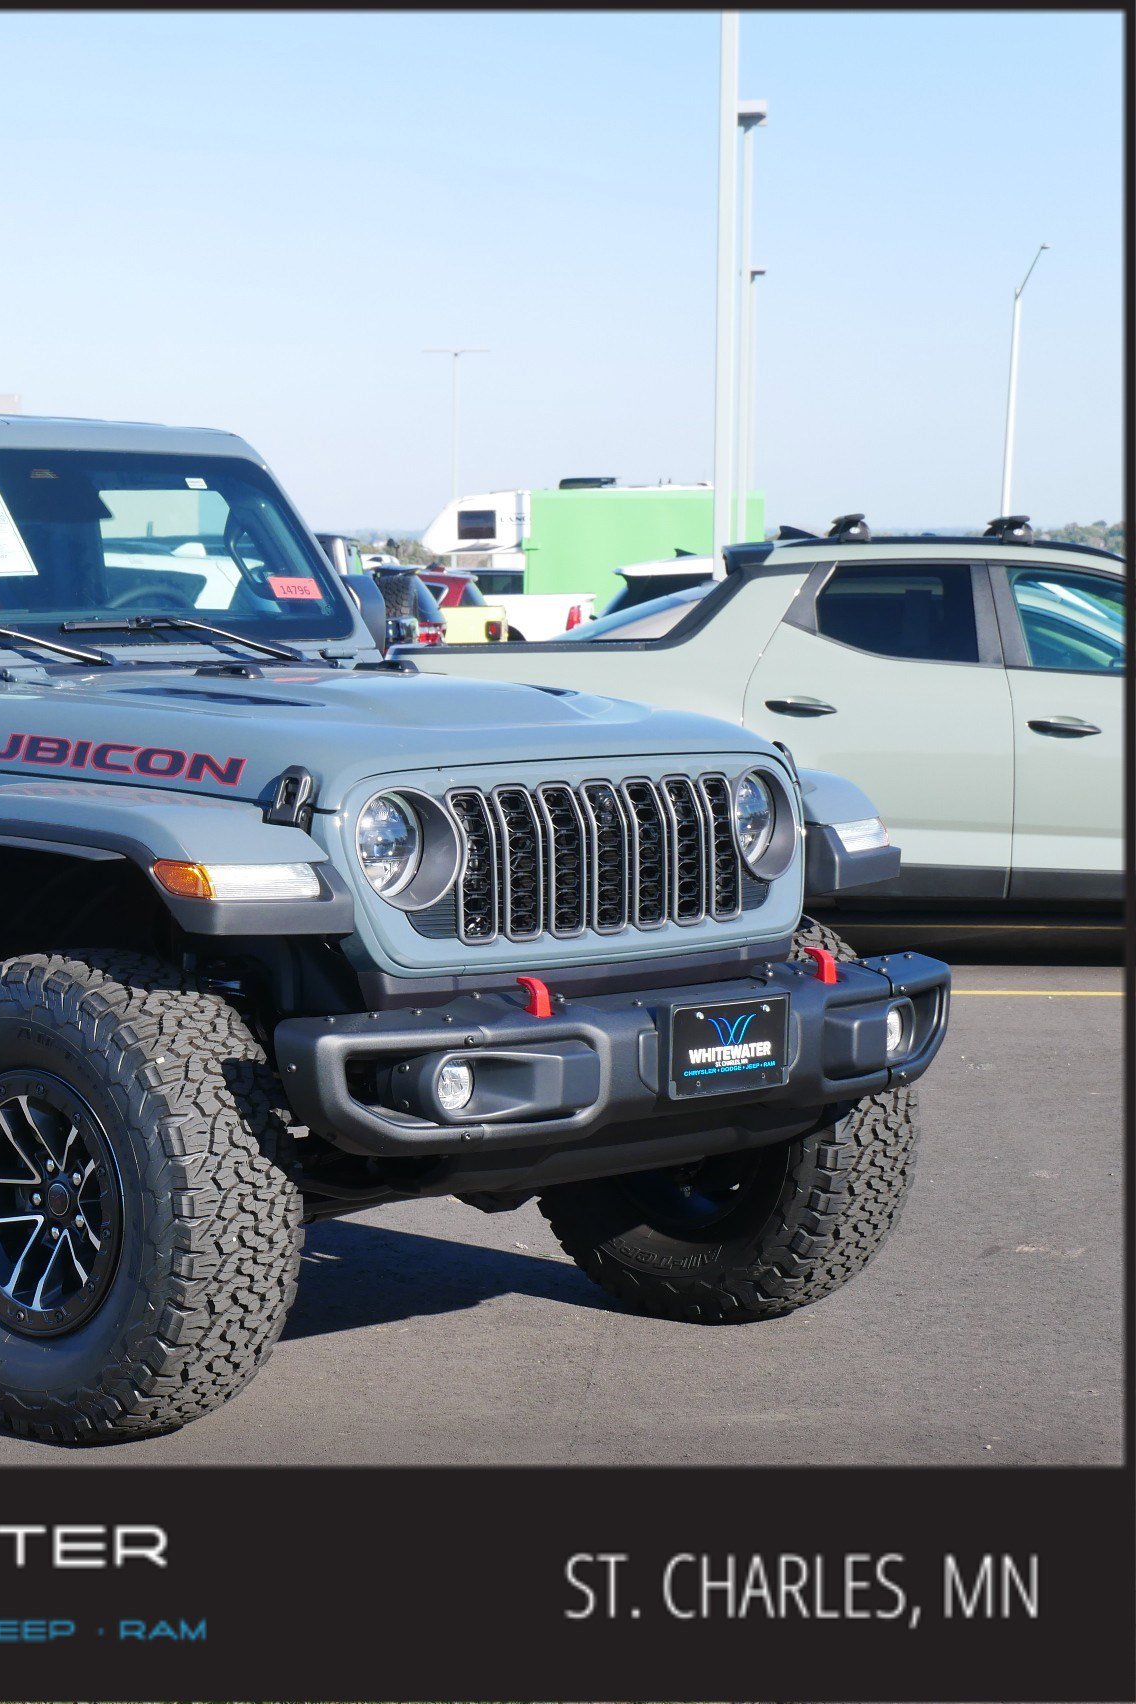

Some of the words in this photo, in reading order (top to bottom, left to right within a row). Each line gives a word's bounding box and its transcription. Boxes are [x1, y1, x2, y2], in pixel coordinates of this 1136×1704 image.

[280, 585, 311, 596] 14796
[688, 1041, 772, 1065] WHITEWATER
[683, 1067, 717, 1077] CHRYSLER
[720, 1065, 742, 1073] DODGE
[745, 1063, 760, 1071] JEEP
[762, 1060, 776, 1068] RAM
